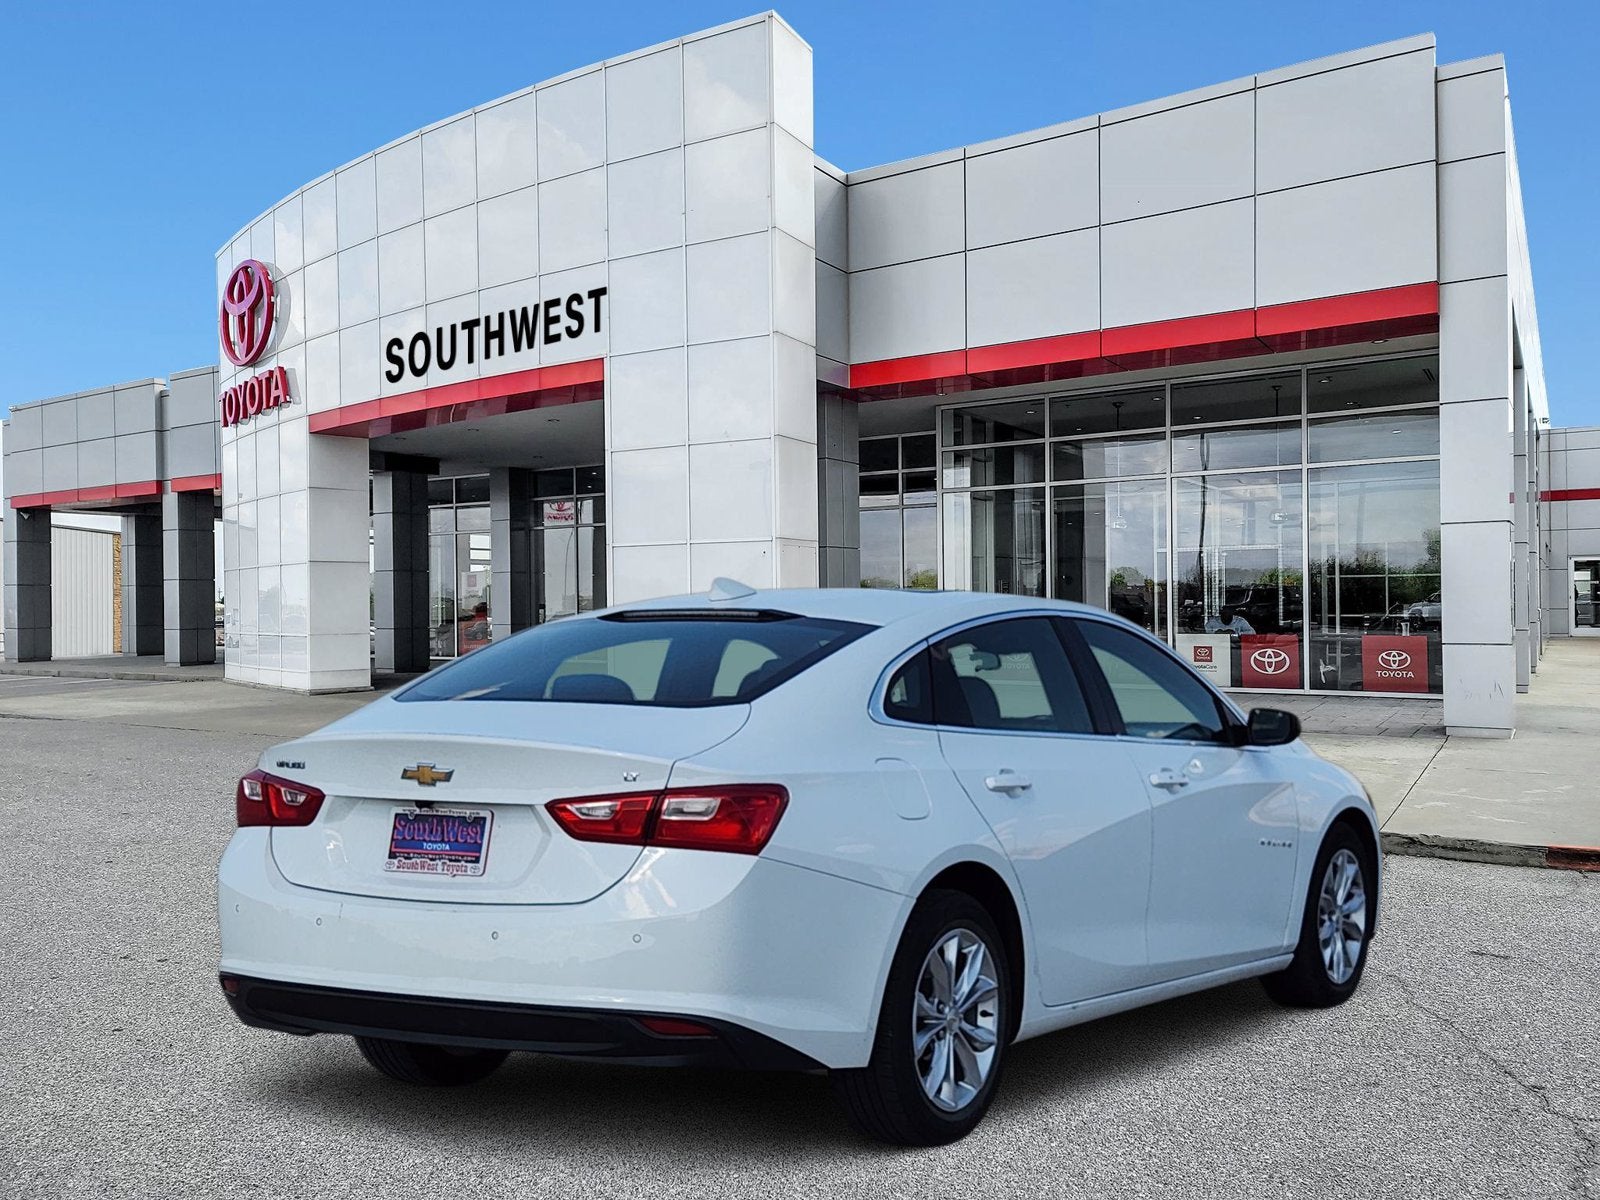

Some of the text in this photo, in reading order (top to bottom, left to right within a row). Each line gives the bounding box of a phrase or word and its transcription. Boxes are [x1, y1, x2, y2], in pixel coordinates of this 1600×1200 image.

[385, 287, 607, 384] SOUTHWEST
[219, 366, 290, 427] TOYOTA
[1375, 670, 1415, 678] TOYOTA
[441, 861, 468, 874] Toyota
